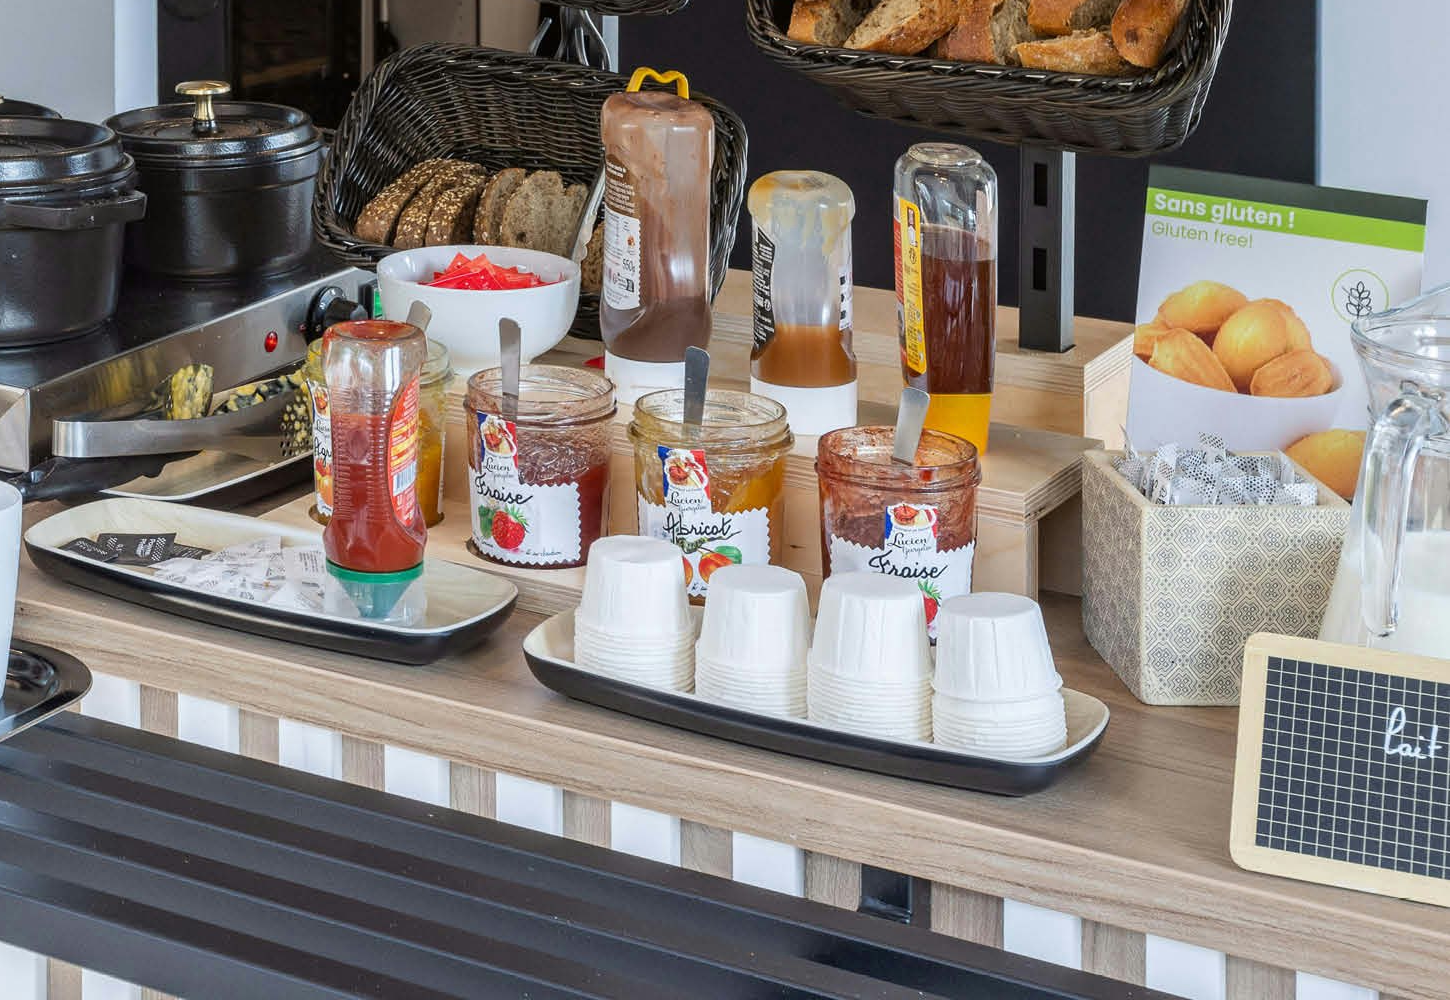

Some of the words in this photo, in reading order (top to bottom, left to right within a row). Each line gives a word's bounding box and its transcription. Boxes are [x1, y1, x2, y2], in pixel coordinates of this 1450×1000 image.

[1153, 192, 1208, 217] Sans
[1211, 198, 1283, 227] gluten
[1287, 210, 1296, 229] !
[1151, 219, 1210, 244] Gluten
[1212, 229, 1254, 249] free!
[483, 456, 511, 473] Lucien
[474, 472, 534, 505] Fraise
[666, 490, 703, 508] Lucien
[662, 511, 733, 545] Abricot
[887, 532, 927, 549] Lucien
[868, 549, 949, 579] Fraise
